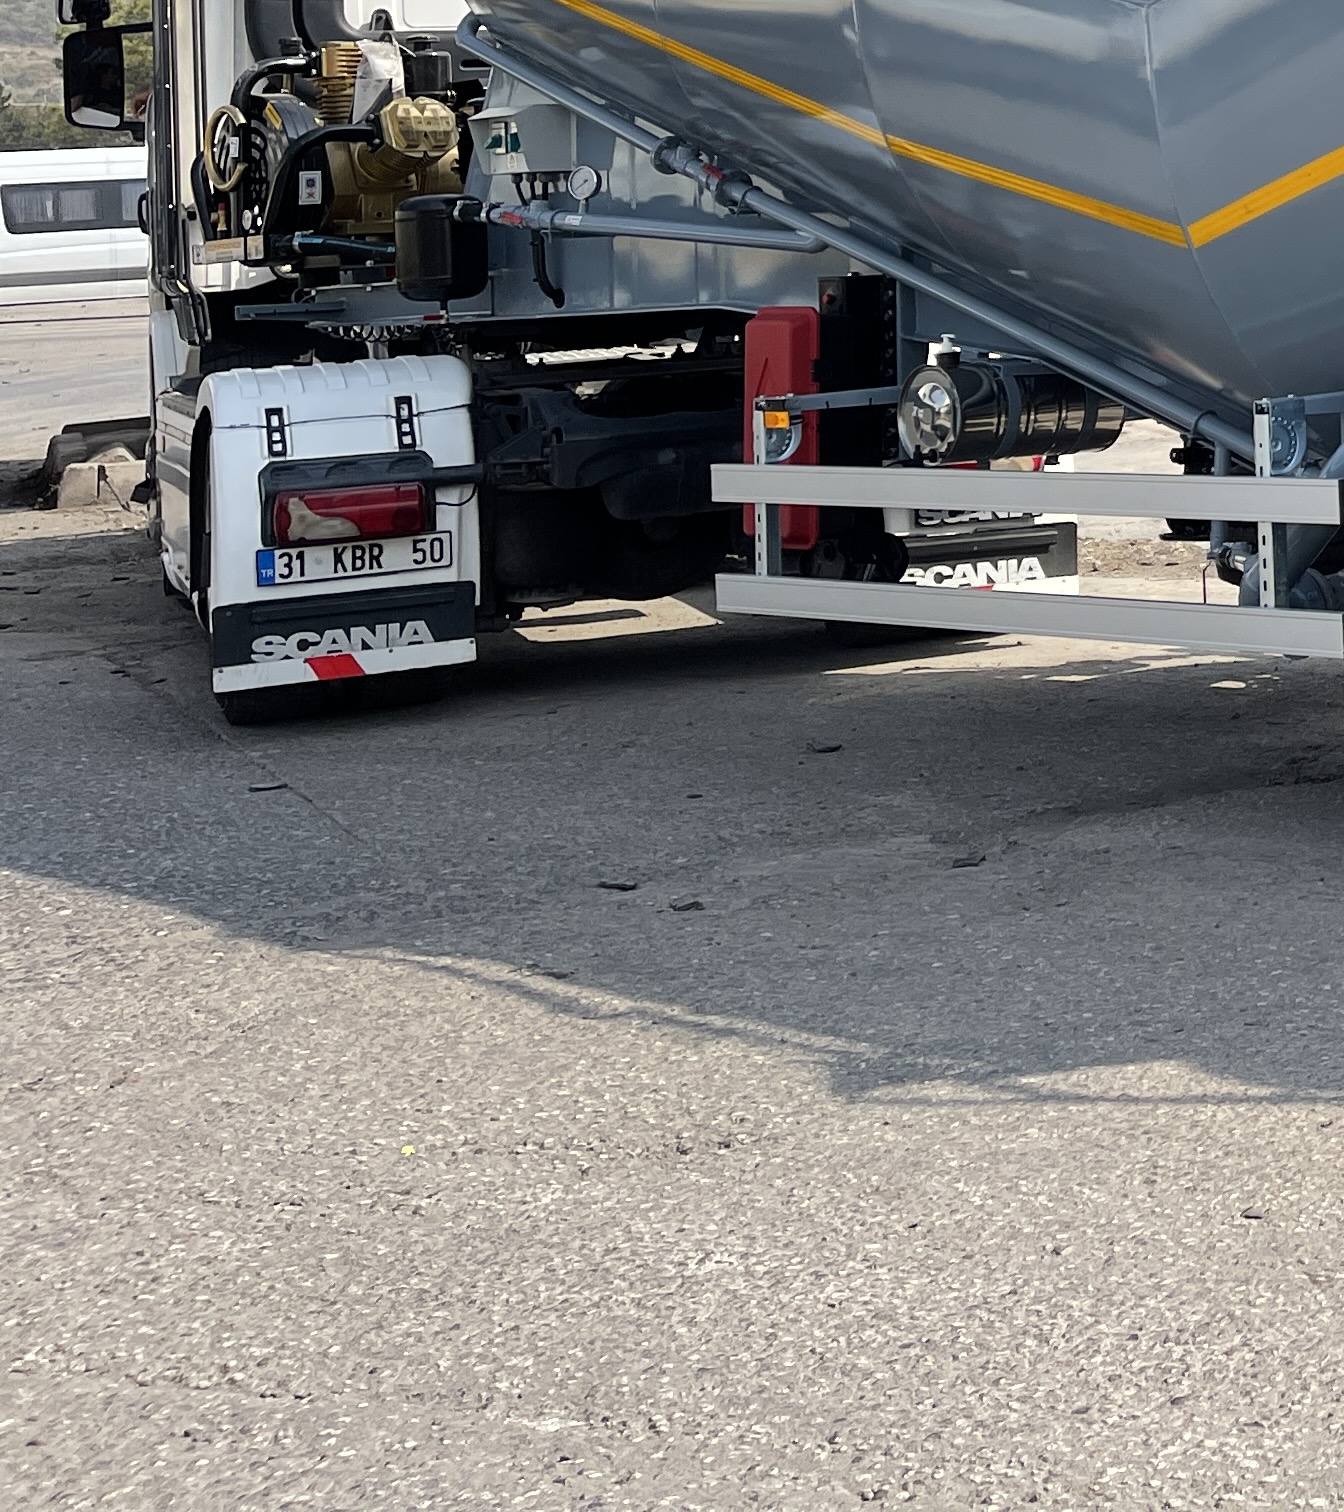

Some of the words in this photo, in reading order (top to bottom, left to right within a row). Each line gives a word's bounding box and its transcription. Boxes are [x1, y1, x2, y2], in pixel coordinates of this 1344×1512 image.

[261, 569, 274, 578] TR
[278, 550, 305, 579] 31
[333, 543, 384, 574] KBR
[412, 537, 444, 565] 50
[250, 619, 435, 663] SCANIA
